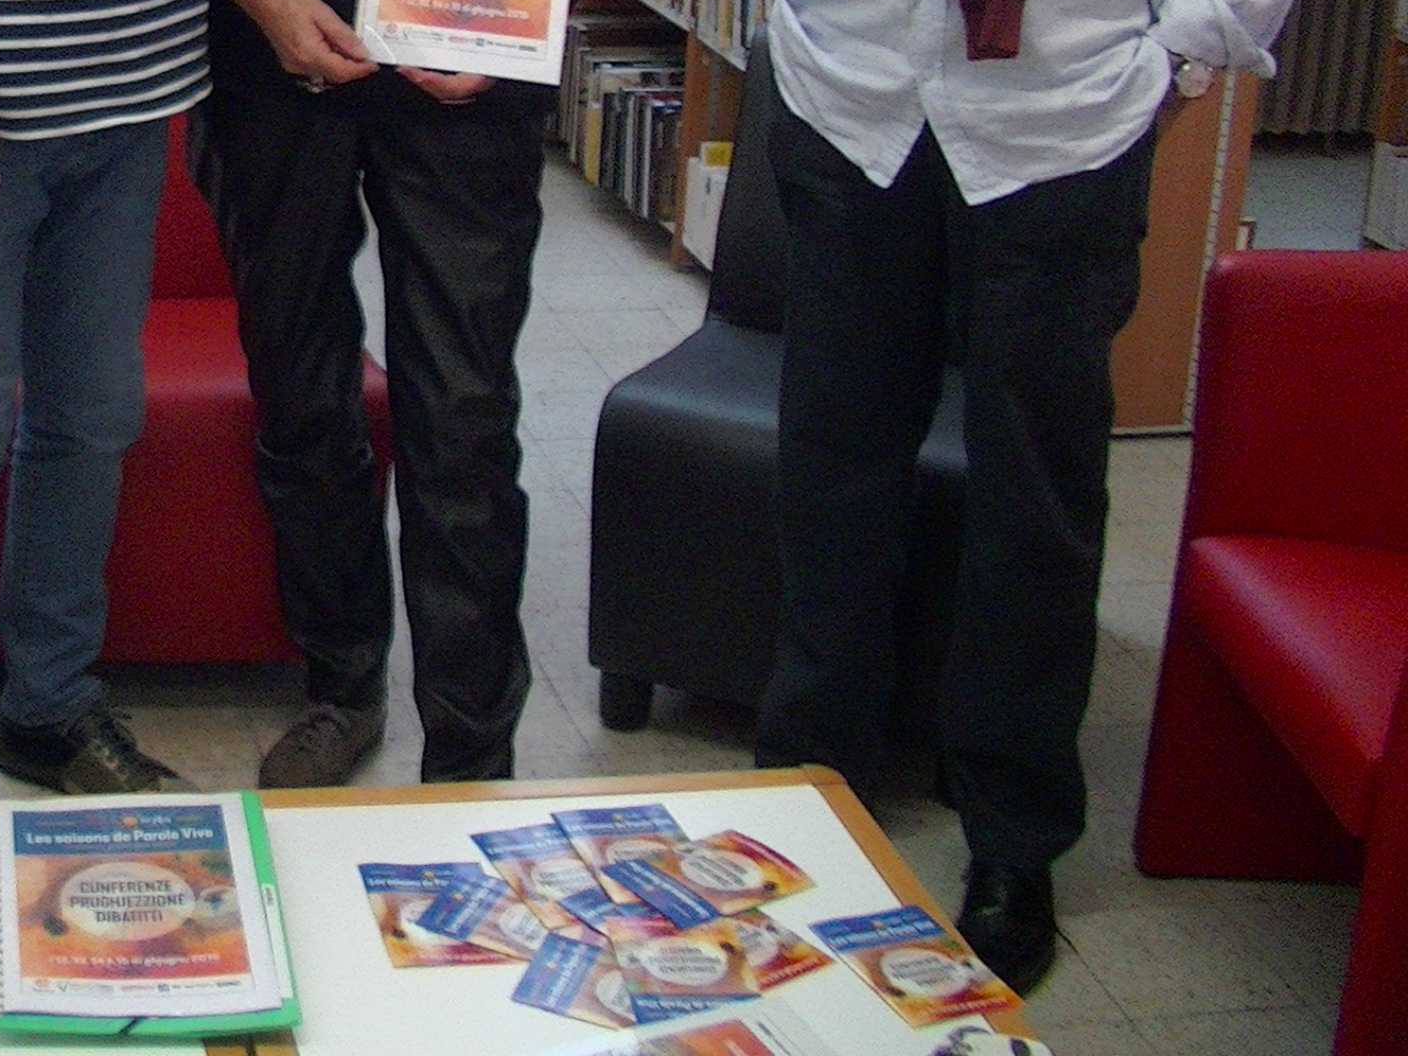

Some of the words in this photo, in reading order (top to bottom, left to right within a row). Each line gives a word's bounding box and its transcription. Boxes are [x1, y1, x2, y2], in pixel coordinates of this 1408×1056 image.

[26, 832, 52, 845] Les
[54, 832, 111, 844] saisons
[112, 831, 131, 843] de
[133, 829, 180, 842] Parole
[180, 827, 213, 840] Vive
[80, 879, 172, 894] CUNFERENZE
[68, 892, 186, 909] PRUGHJEZZIONE
[95, 909, 164, 923] DIBATITTI
